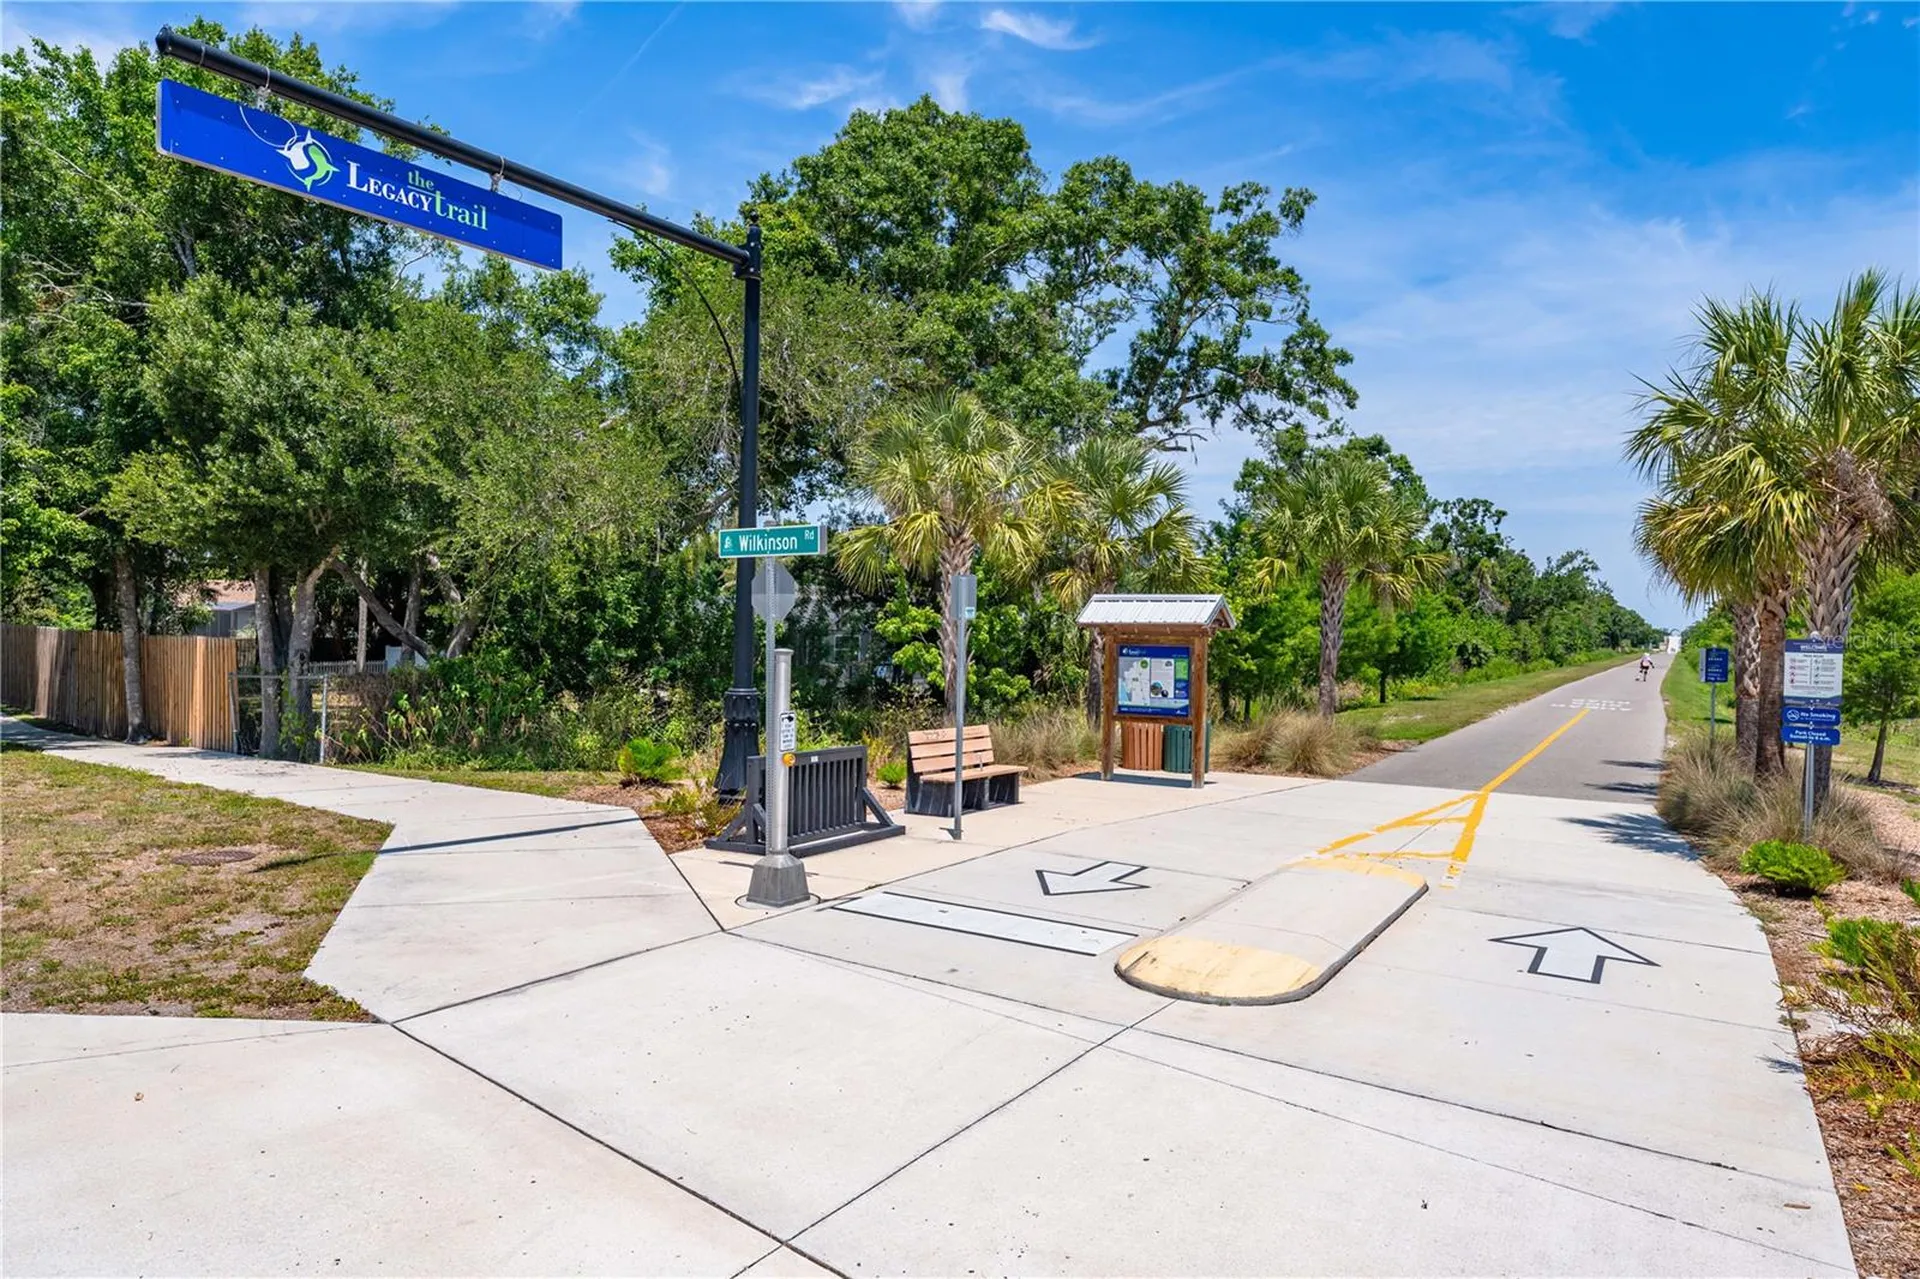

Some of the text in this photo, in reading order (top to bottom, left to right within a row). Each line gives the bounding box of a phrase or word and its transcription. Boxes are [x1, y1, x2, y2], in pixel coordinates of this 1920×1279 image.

[407, 170, 434, 191] the
[346, 160, 488, 231] LEGACY trail
[739, 530, 815, 552] Wilkinson Rd
[1810, 712, 1836, 721] Smoking
